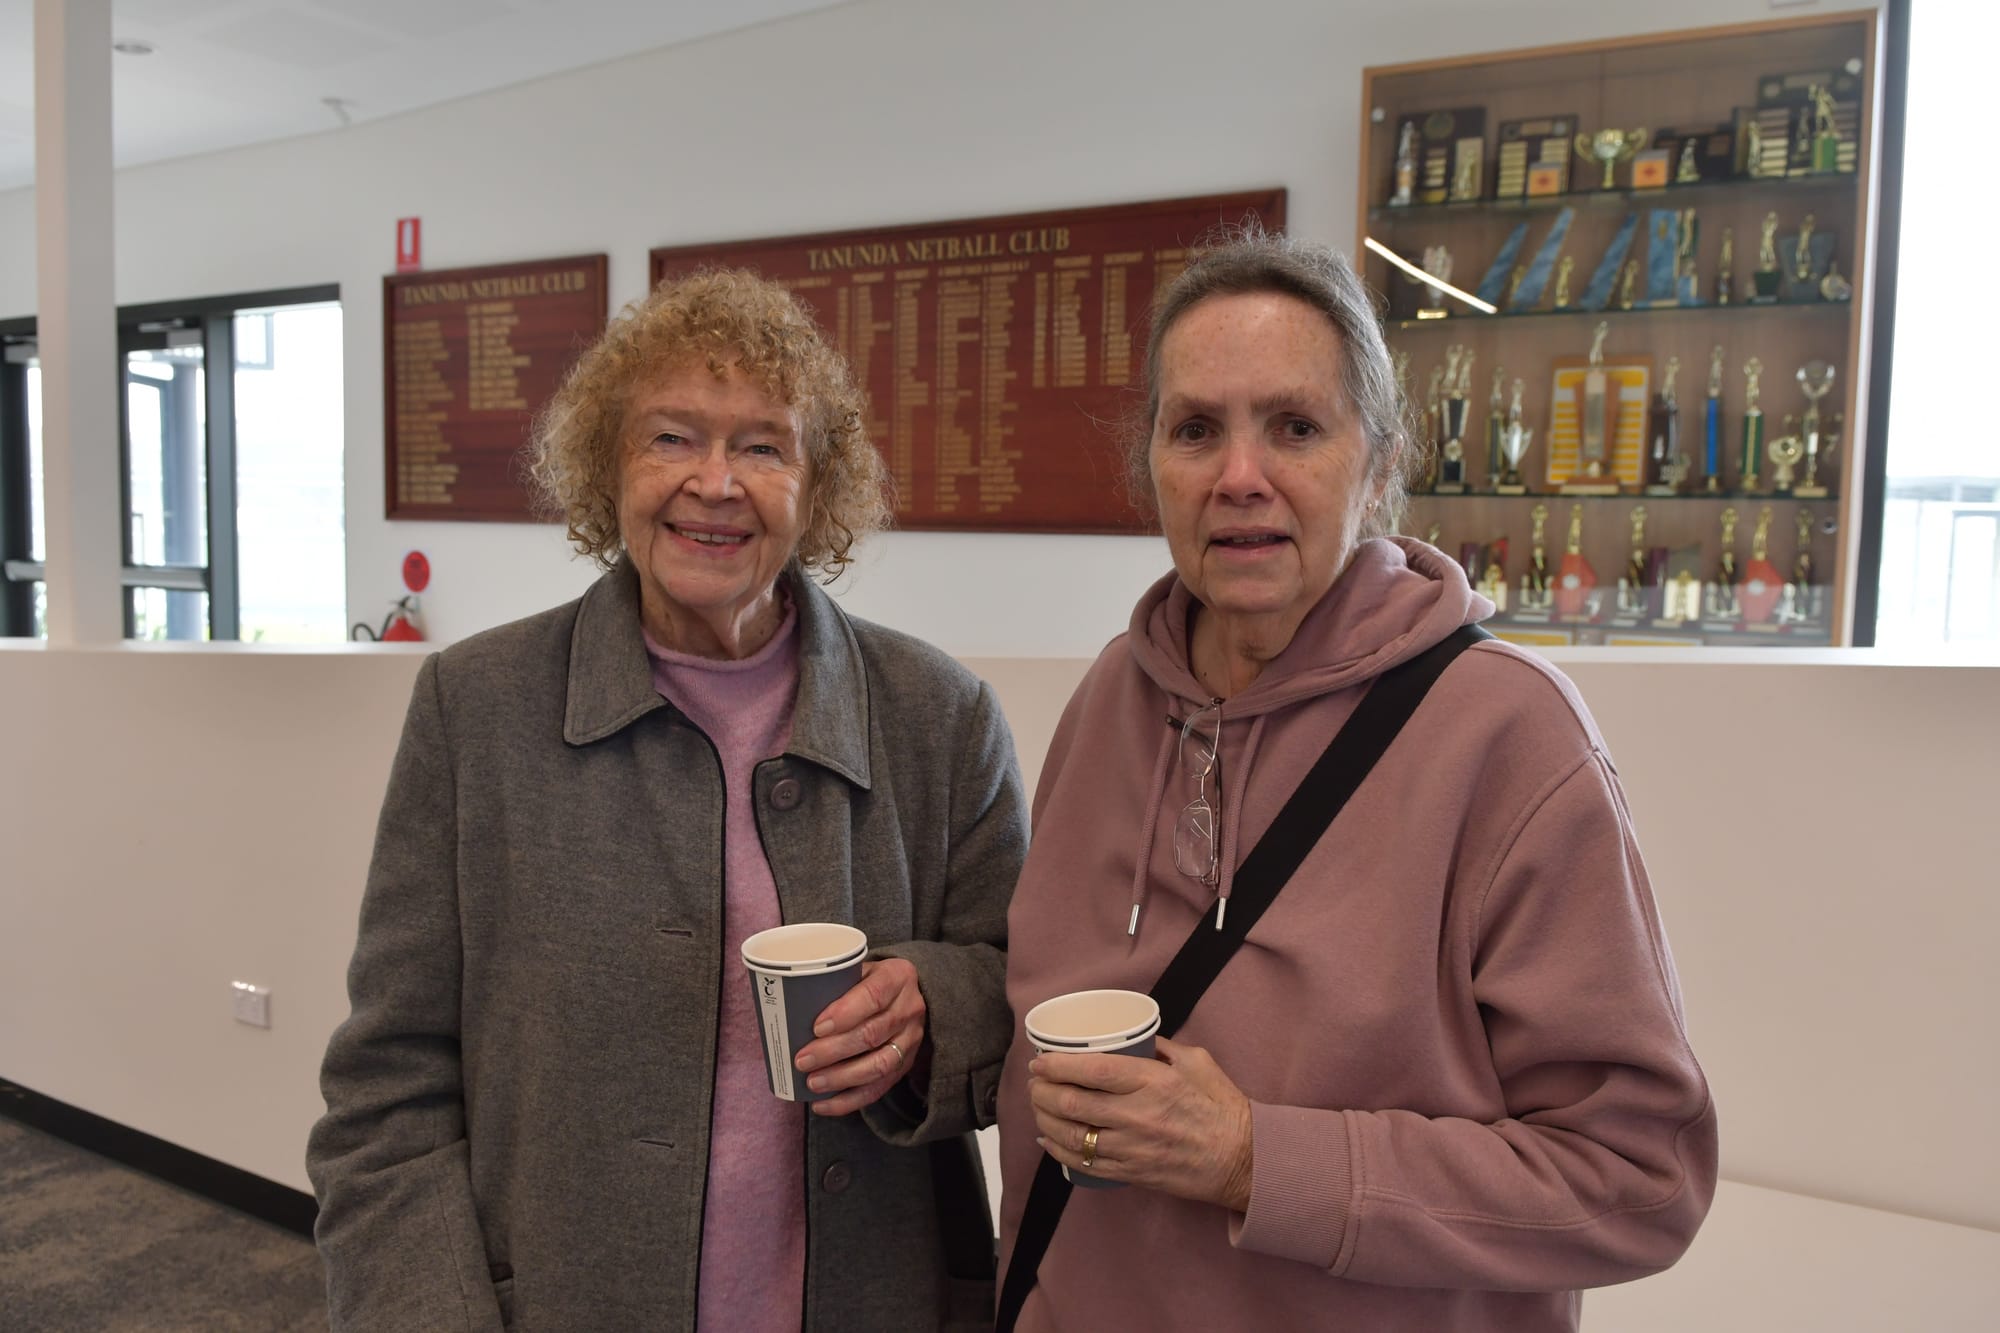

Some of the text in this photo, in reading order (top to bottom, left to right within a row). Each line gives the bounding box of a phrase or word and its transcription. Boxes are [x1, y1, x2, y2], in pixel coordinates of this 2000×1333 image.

[807, 227, 1070, 272] TANUNDA NETBALL CLUB
[404, 271, 586, 305] TANUNDA NETBALL CLUB
